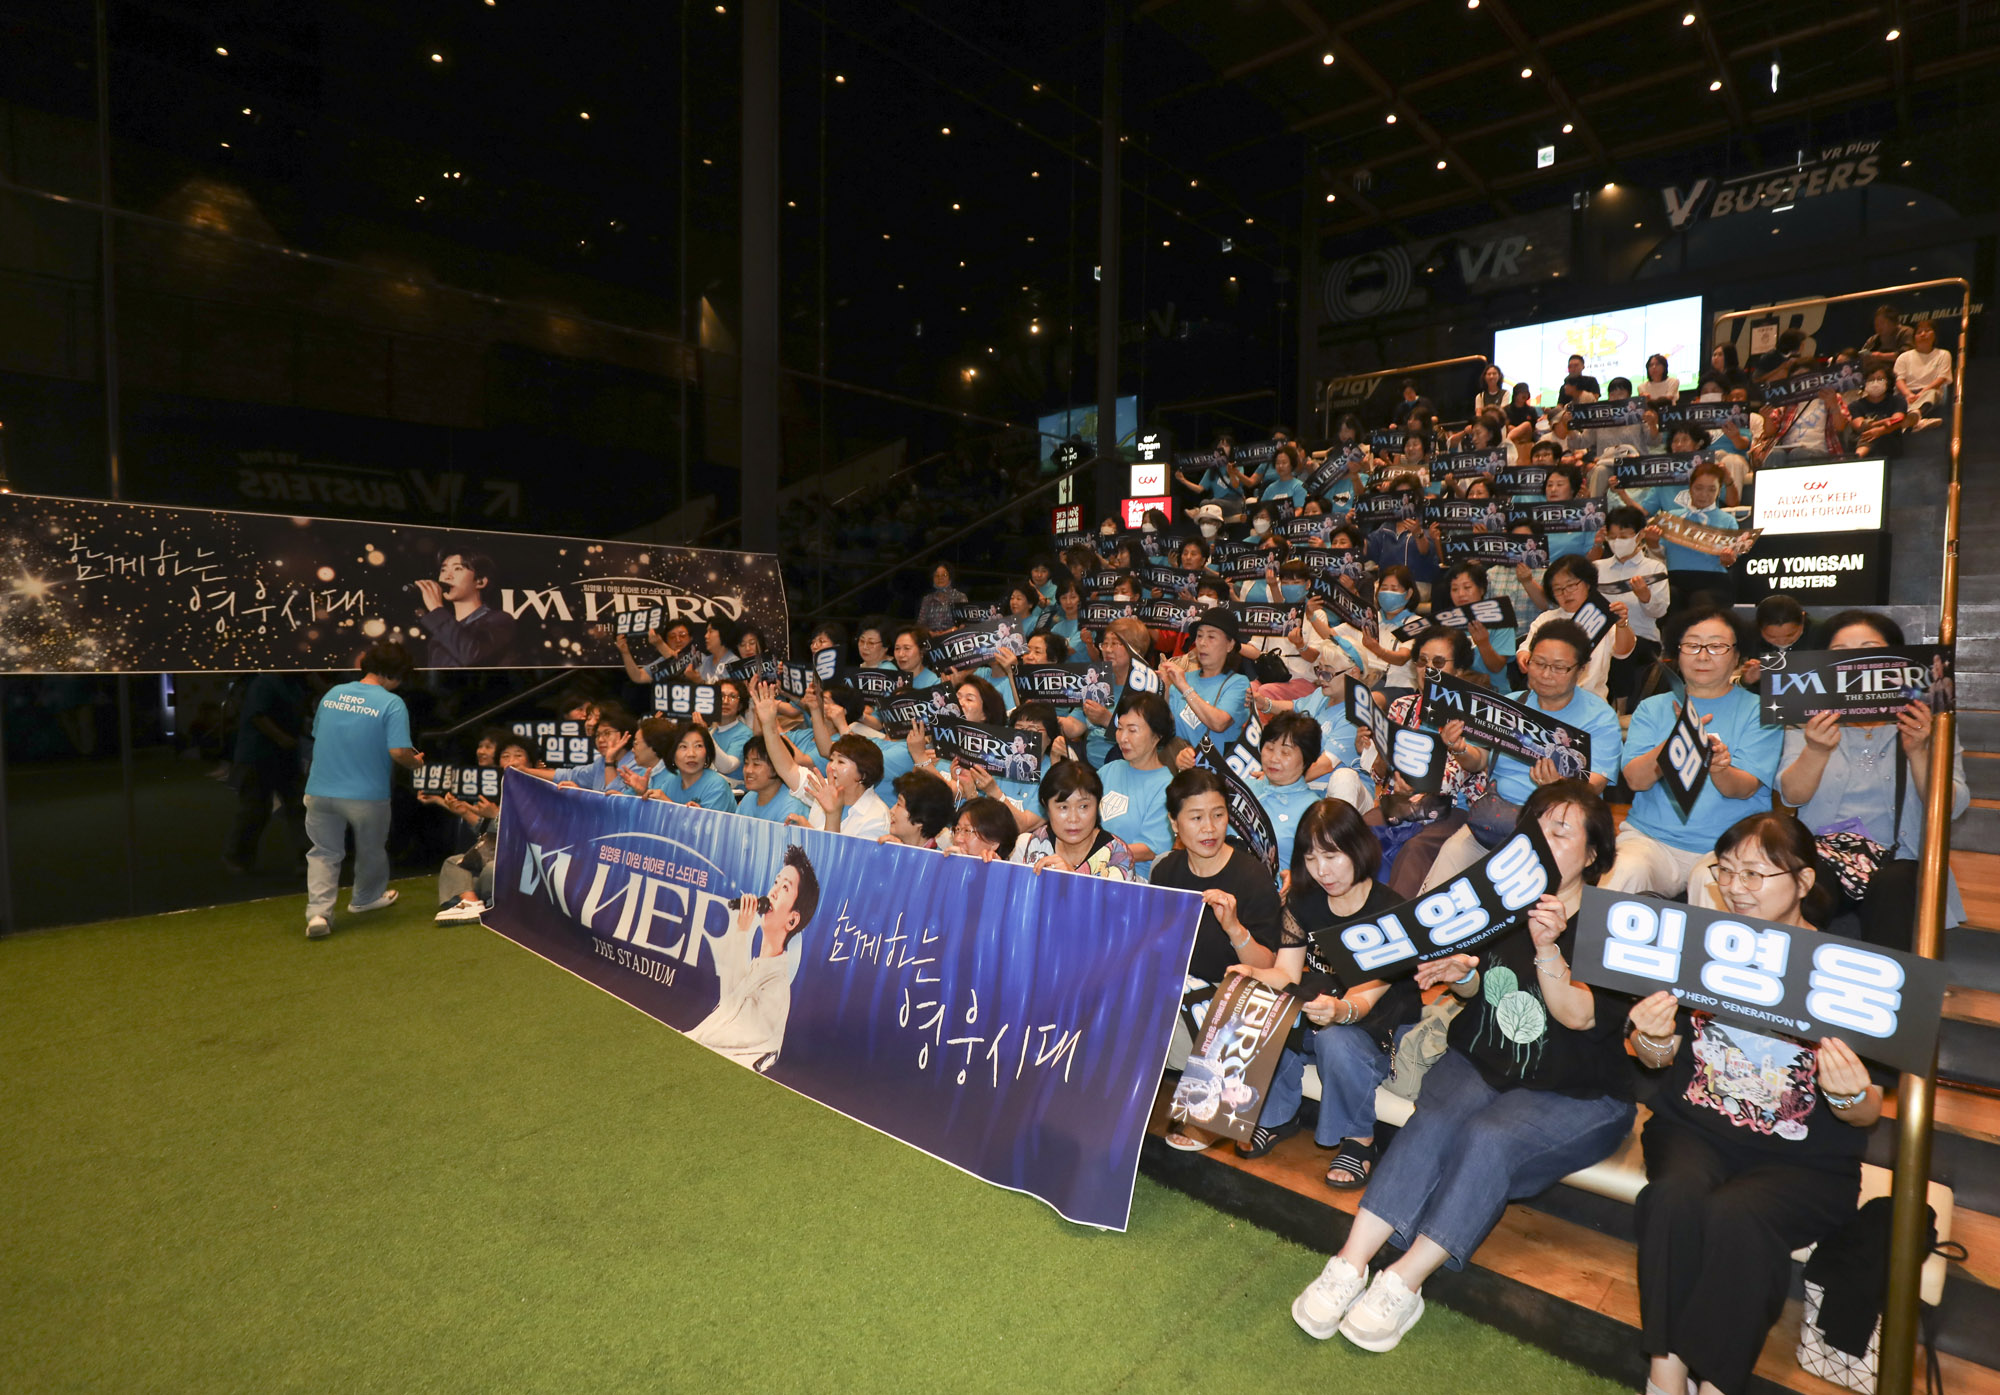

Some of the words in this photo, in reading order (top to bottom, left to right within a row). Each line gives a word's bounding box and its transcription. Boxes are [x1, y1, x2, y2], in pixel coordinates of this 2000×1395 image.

[1710, 156, 1881, 219] BUSTERS
[1459, 235, 1528, 285] VR
[1138, 476, 1158, 485] CGV
[1803, 481, 1828, 490] CGV
[1763, 507, 1808, 519] MOVING
[1812, 504, 1872, 517] FORWARD
[1778, 493, 1823, 505] ALWAYS
[1827, 491, 1857, 502] KEEP
[69, 533, 228, 582] 함께하는
[1746, 558, 1780, 575] CGV
[1783, 554, 1864, 573] YONGSAN
[1768, 576, 1779, 589] V
[1780, 574, 1837, 589] BUSTERS
[189, 579, 366, 635] 영웅시대
[323, 700, 379, 718] GENERATION
[338, 693, 365, 705] HERO
[654, 684, 715, 715] 임영웅
[1848, 707, 1878, 715] WOONG
[1474, 717, 1487, 727] THE
[1474, 729, 1493, 741] WOONG
[599, 845, 621, 866] 임영웅
[626, 853, 643, 871] 아임
[643, 856, 666, 878] 히어로
[666, 862, 675, 880] 더
[675, 864, 709, 888] 스타디움
[1340, 833, 1548, 972] 임영웅
[829, 898, 940, 983] 함께하는
[1429, 945, 1455, 960] HERO
[1455, 921, 1507, 950] GENERATION
[592, 937, 616, 961] THE
[618, 948, 677, 988] STADIUM
[1602, 900, 1905, 1039] 임영웅
[1685, 990, 1719, 1007] HERO
[1721, 1000, 1795, 1028] GENERATION
[899, 988, 1082, 1088] 영웅시대
